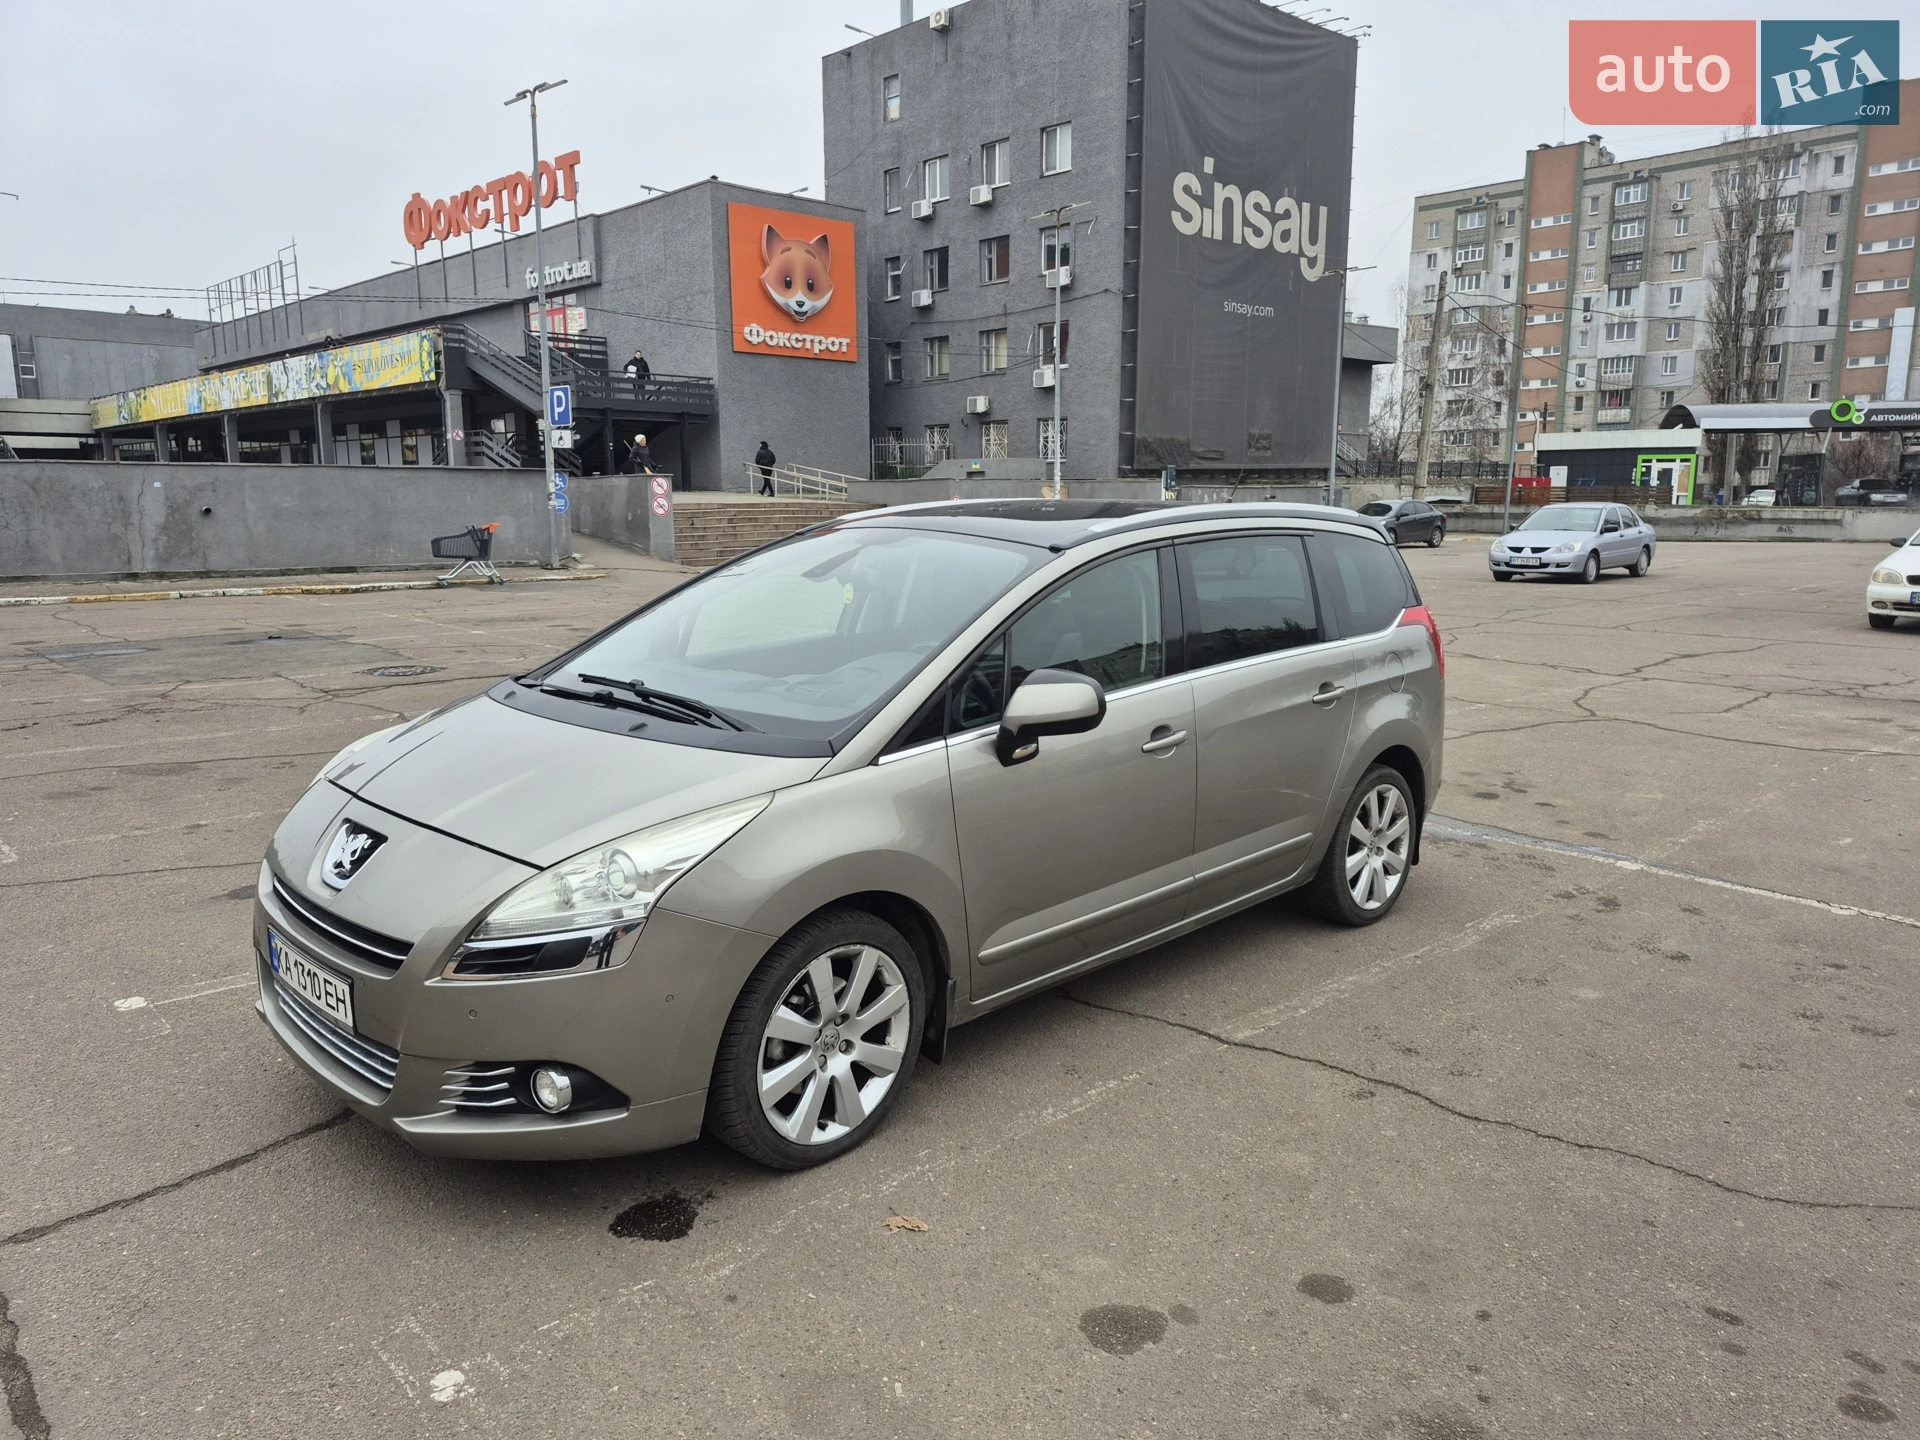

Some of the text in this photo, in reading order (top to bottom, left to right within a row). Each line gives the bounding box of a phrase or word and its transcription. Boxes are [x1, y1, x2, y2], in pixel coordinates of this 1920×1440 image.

[403, 150, 581, 250] Фокстрот
[1171, 155, 1328, 282] sinsay
[525, 260, 592, 290] fotrot.ua
[1223, 298, 1275, 318] sinsay.com
[743, 323, 851, 354] Фокстрот
[553, 390, 566, 421] P
[294, 958, 322, 1001] 1310
[323, 976, 348, 1019] EH
